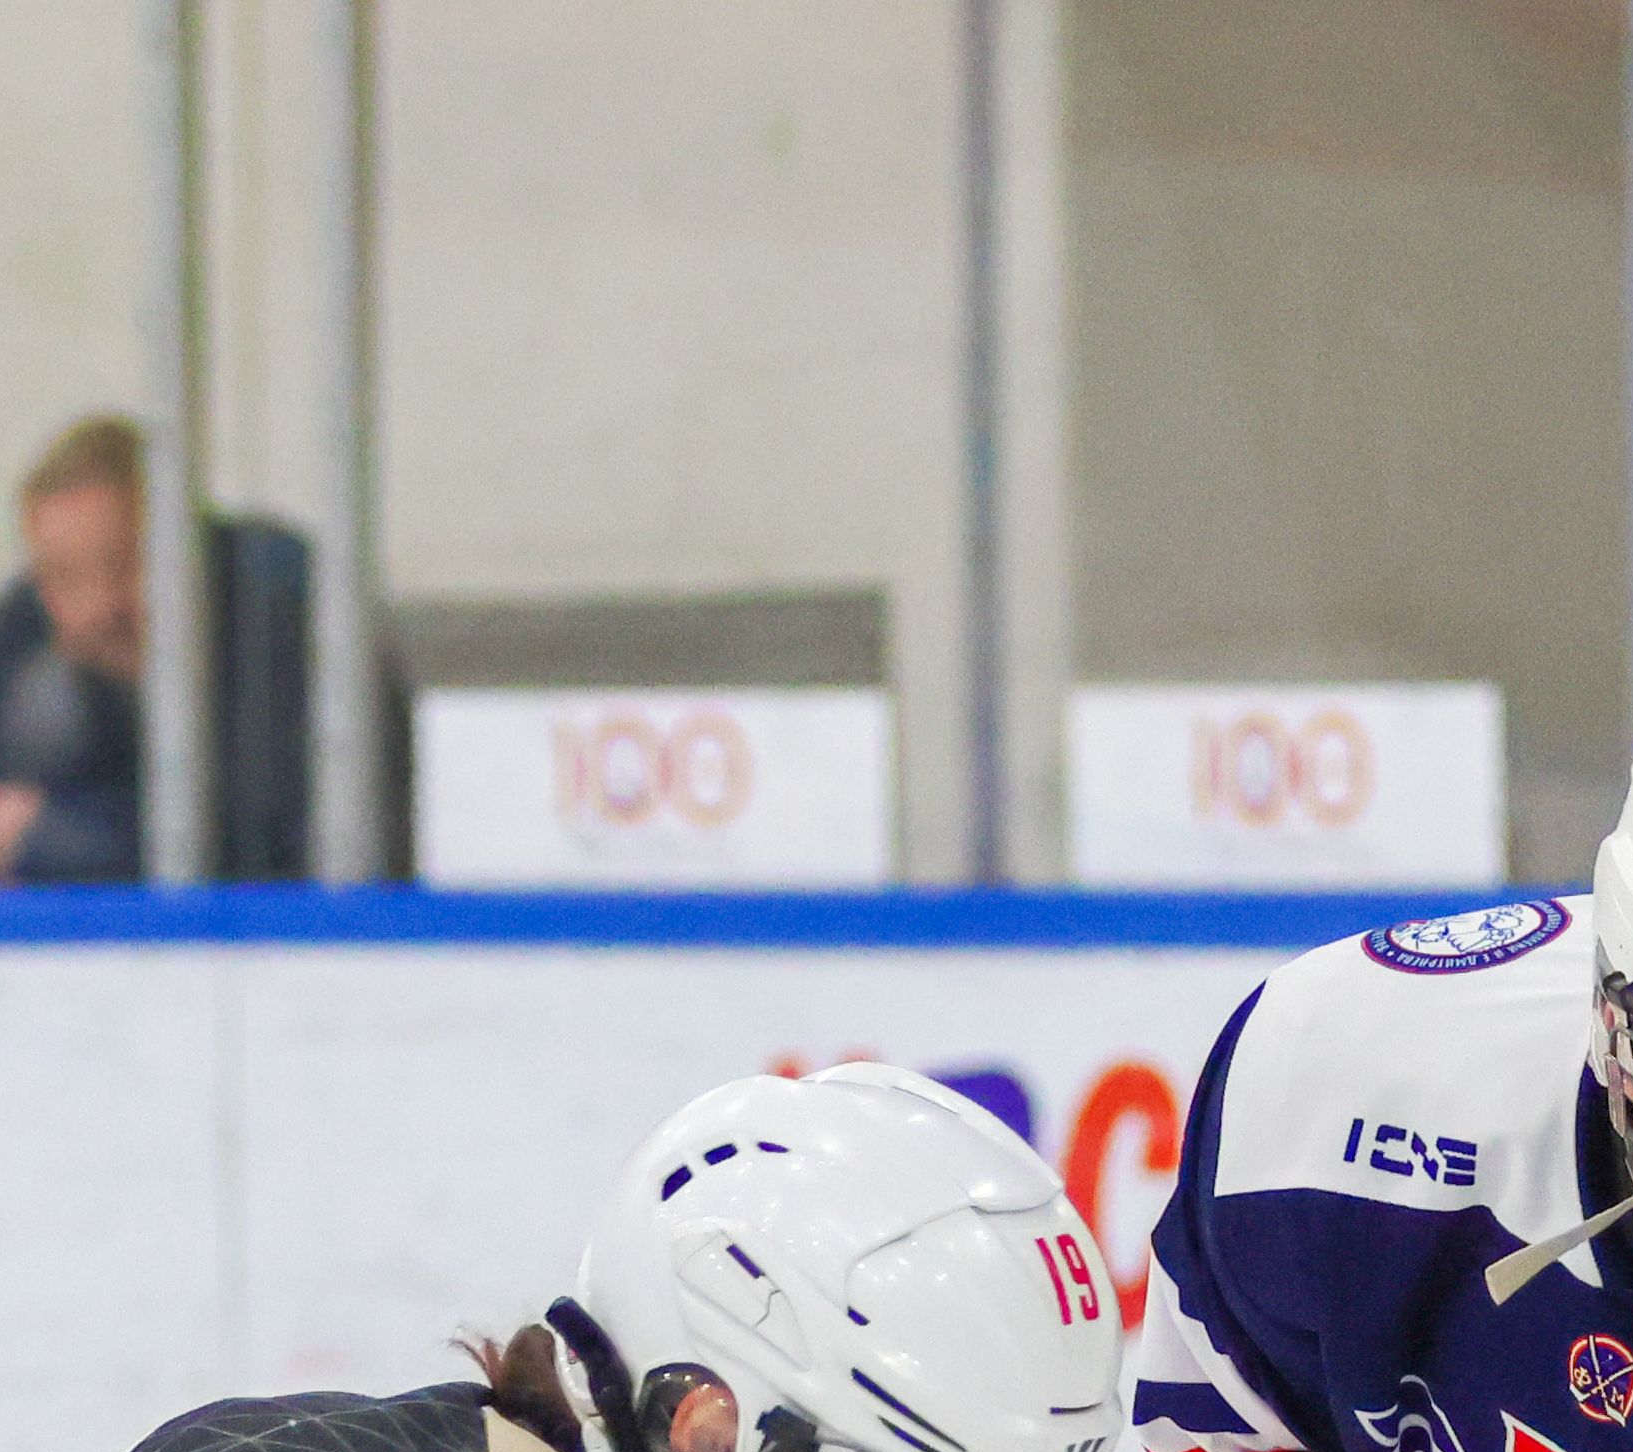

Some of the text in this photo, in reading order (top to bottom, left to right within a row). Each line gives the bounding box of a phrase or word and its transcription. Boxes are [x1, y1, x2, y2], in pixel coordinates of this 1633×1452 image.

[551, 708, 755, 830] 100
[1189, 706, 1377, 828] 100
[1035, 1234, 1099, 1325] 19
